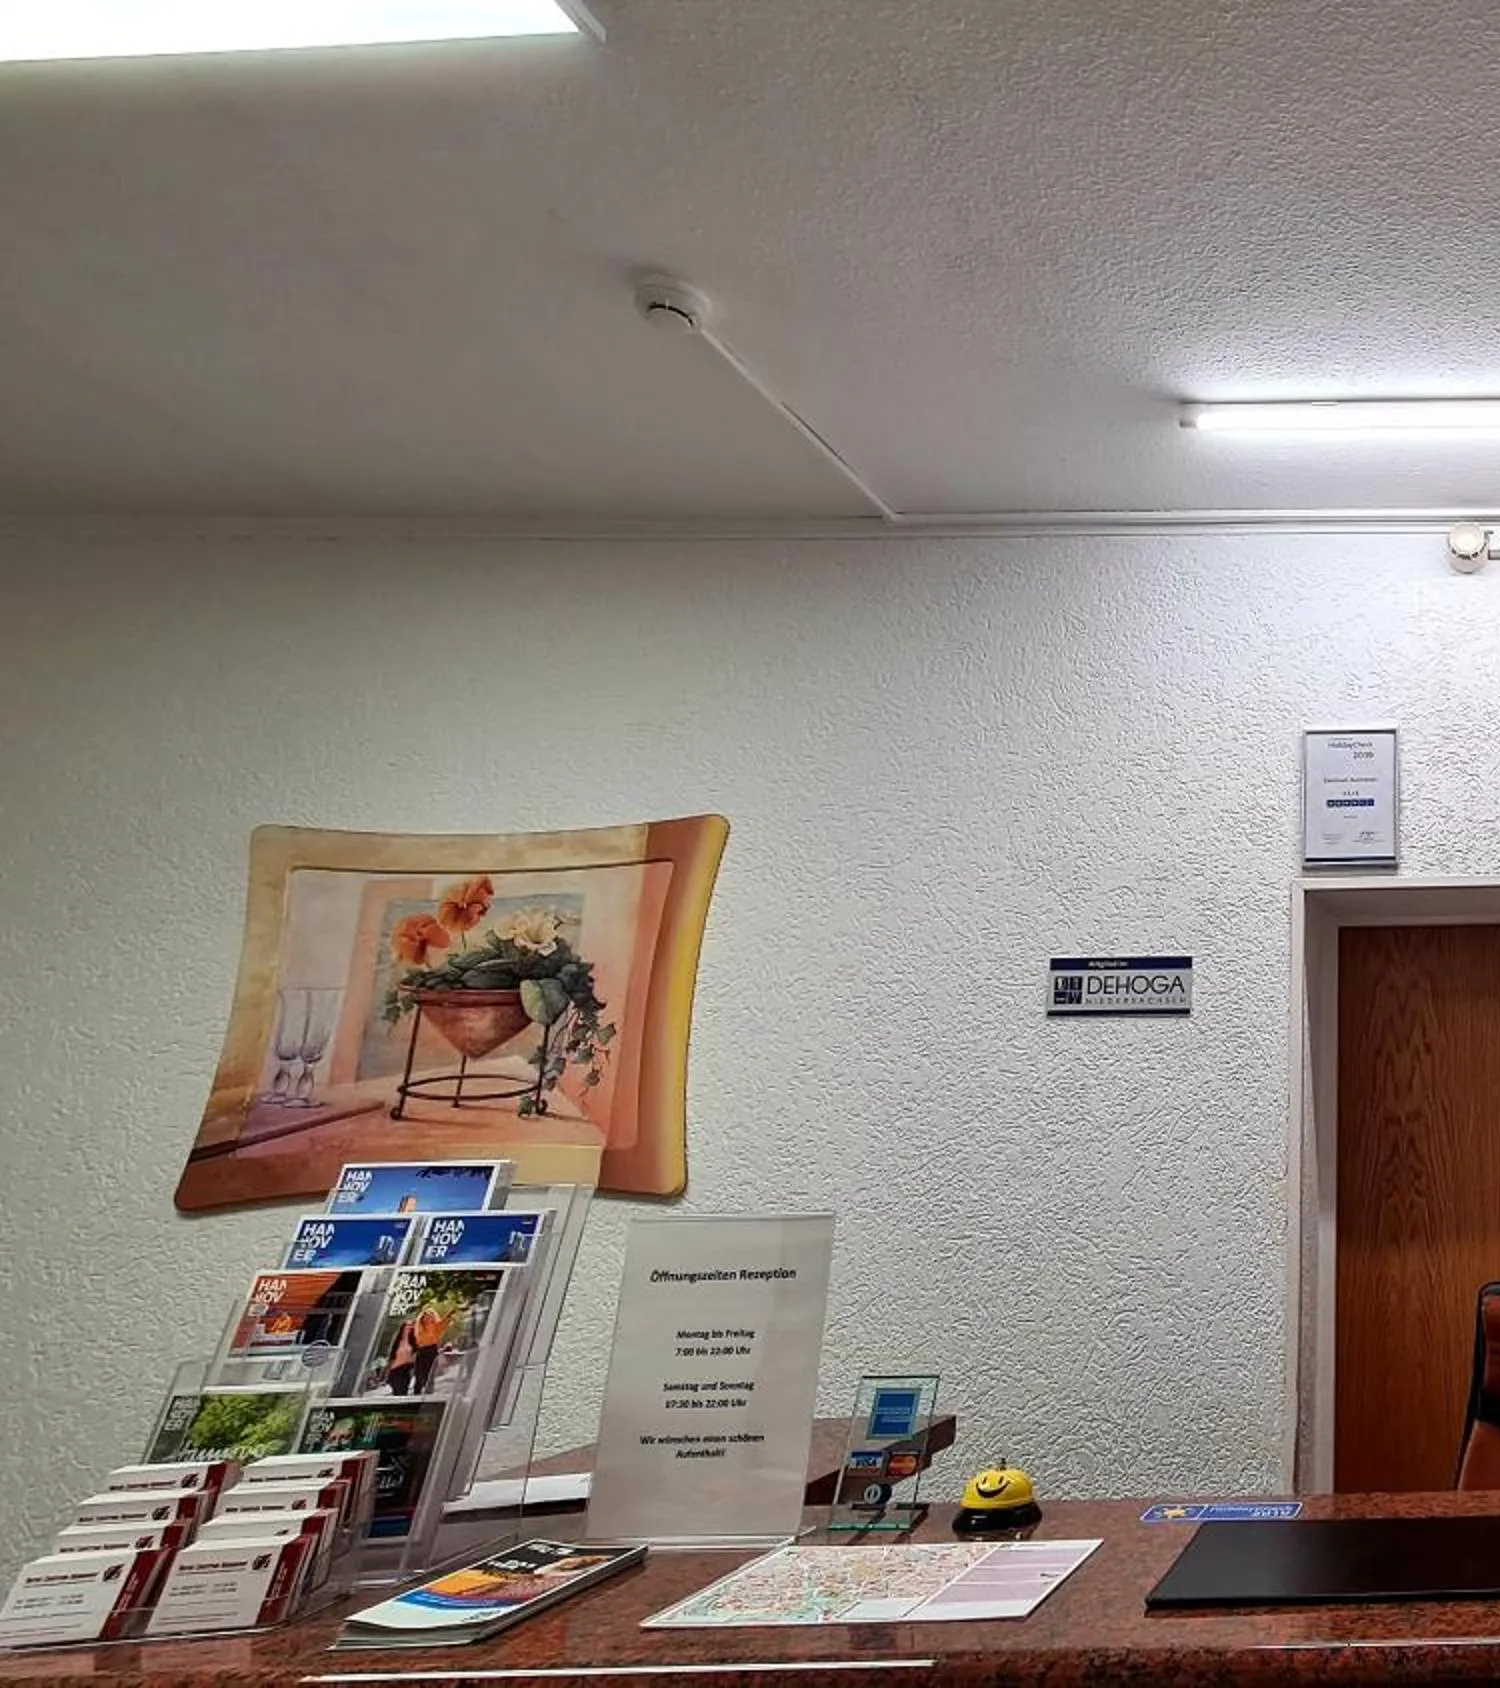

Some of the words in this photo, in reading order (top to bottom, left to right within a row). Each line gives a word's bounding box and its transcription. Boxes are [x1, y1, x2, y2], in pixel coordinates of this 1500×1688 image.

[1087, 975, 1186, 995] DEHOGA
[649, 1268, 737, 1285] Öffnungszeiten
[739, 1267, 798, 1283] Rezeption
[675, 1330, 710, 1341] Montag
[711, 1329, 724, 1338] bis
[725, 1328, 756, 1339] Freitag
[663, 1382, 699, 1393] Samstag
[700, 1381, 718, 1391] und
[719, 1380, 755, 1392] Sonntag
